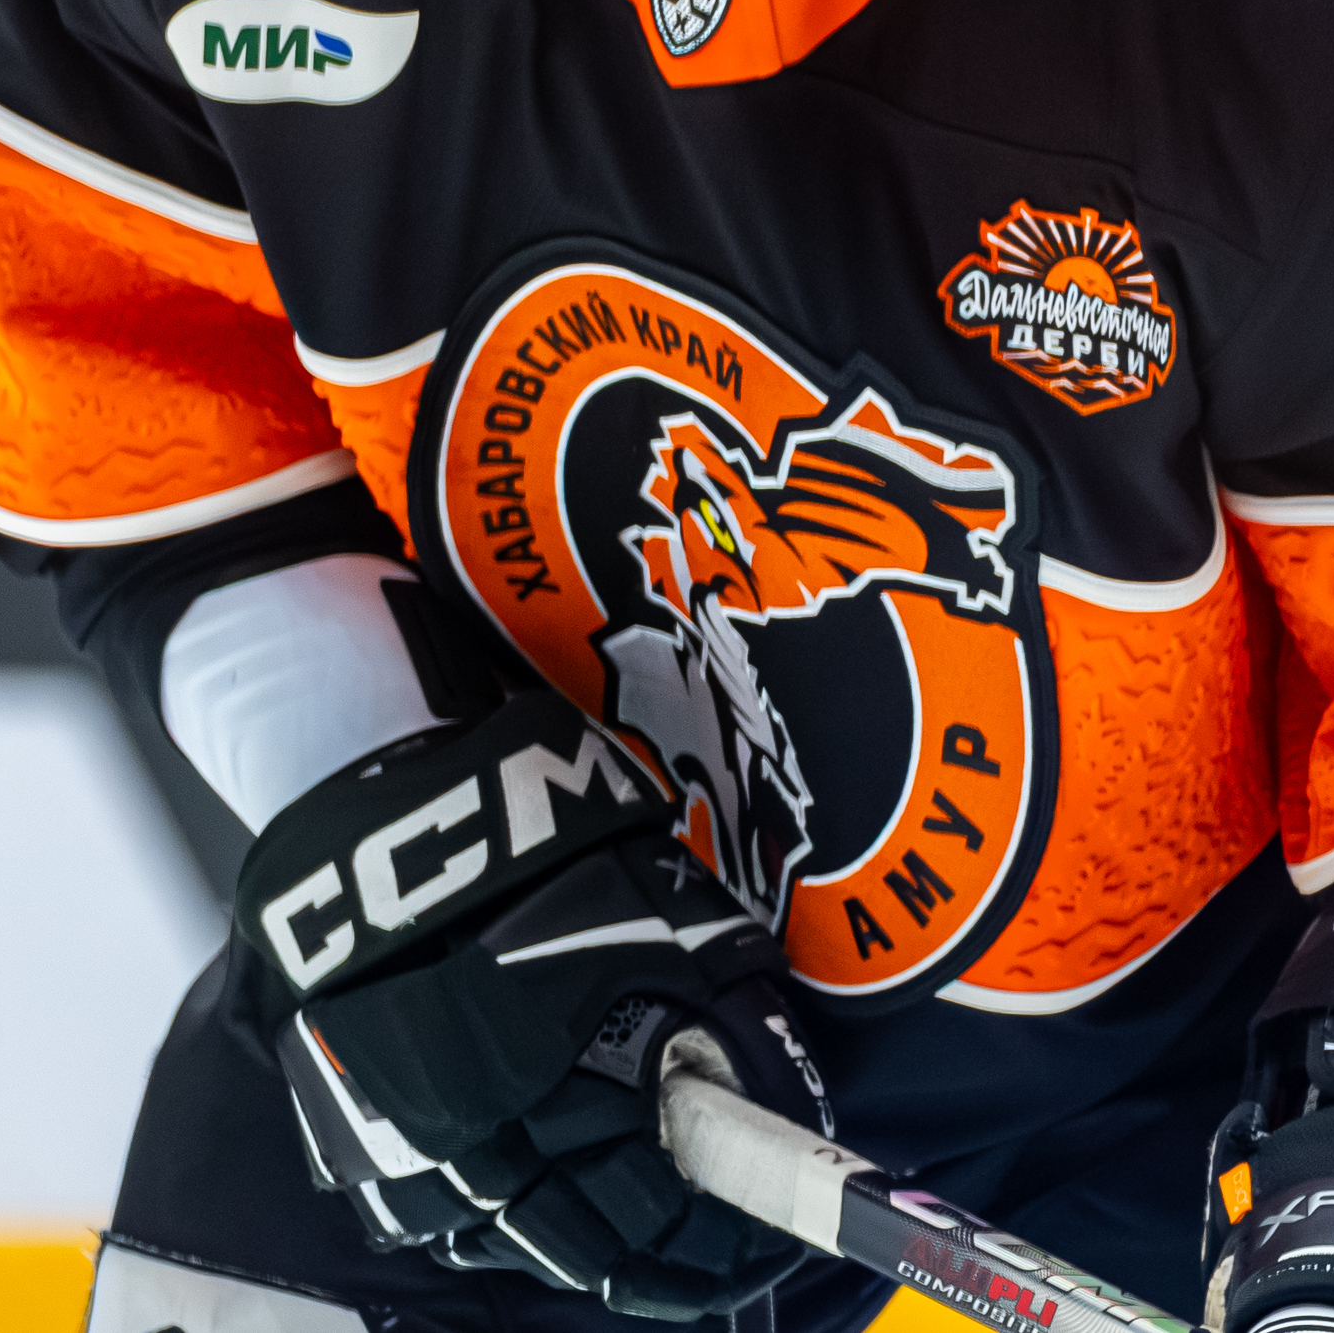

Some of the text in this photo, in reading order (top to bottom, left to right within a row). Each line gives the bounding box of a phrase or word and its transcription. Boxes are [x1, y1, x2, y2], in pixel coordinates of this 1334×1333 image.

[203, 22, 353, 75] МИР
[478, 292, 744, 602] ХАБАРОВСКИЙ КРАЙ
[1007, 324, 1144, 377] ДЕРБИ
[262, 729, 640, 990] CCM
[843, 721, 1001, 961] АМУР
